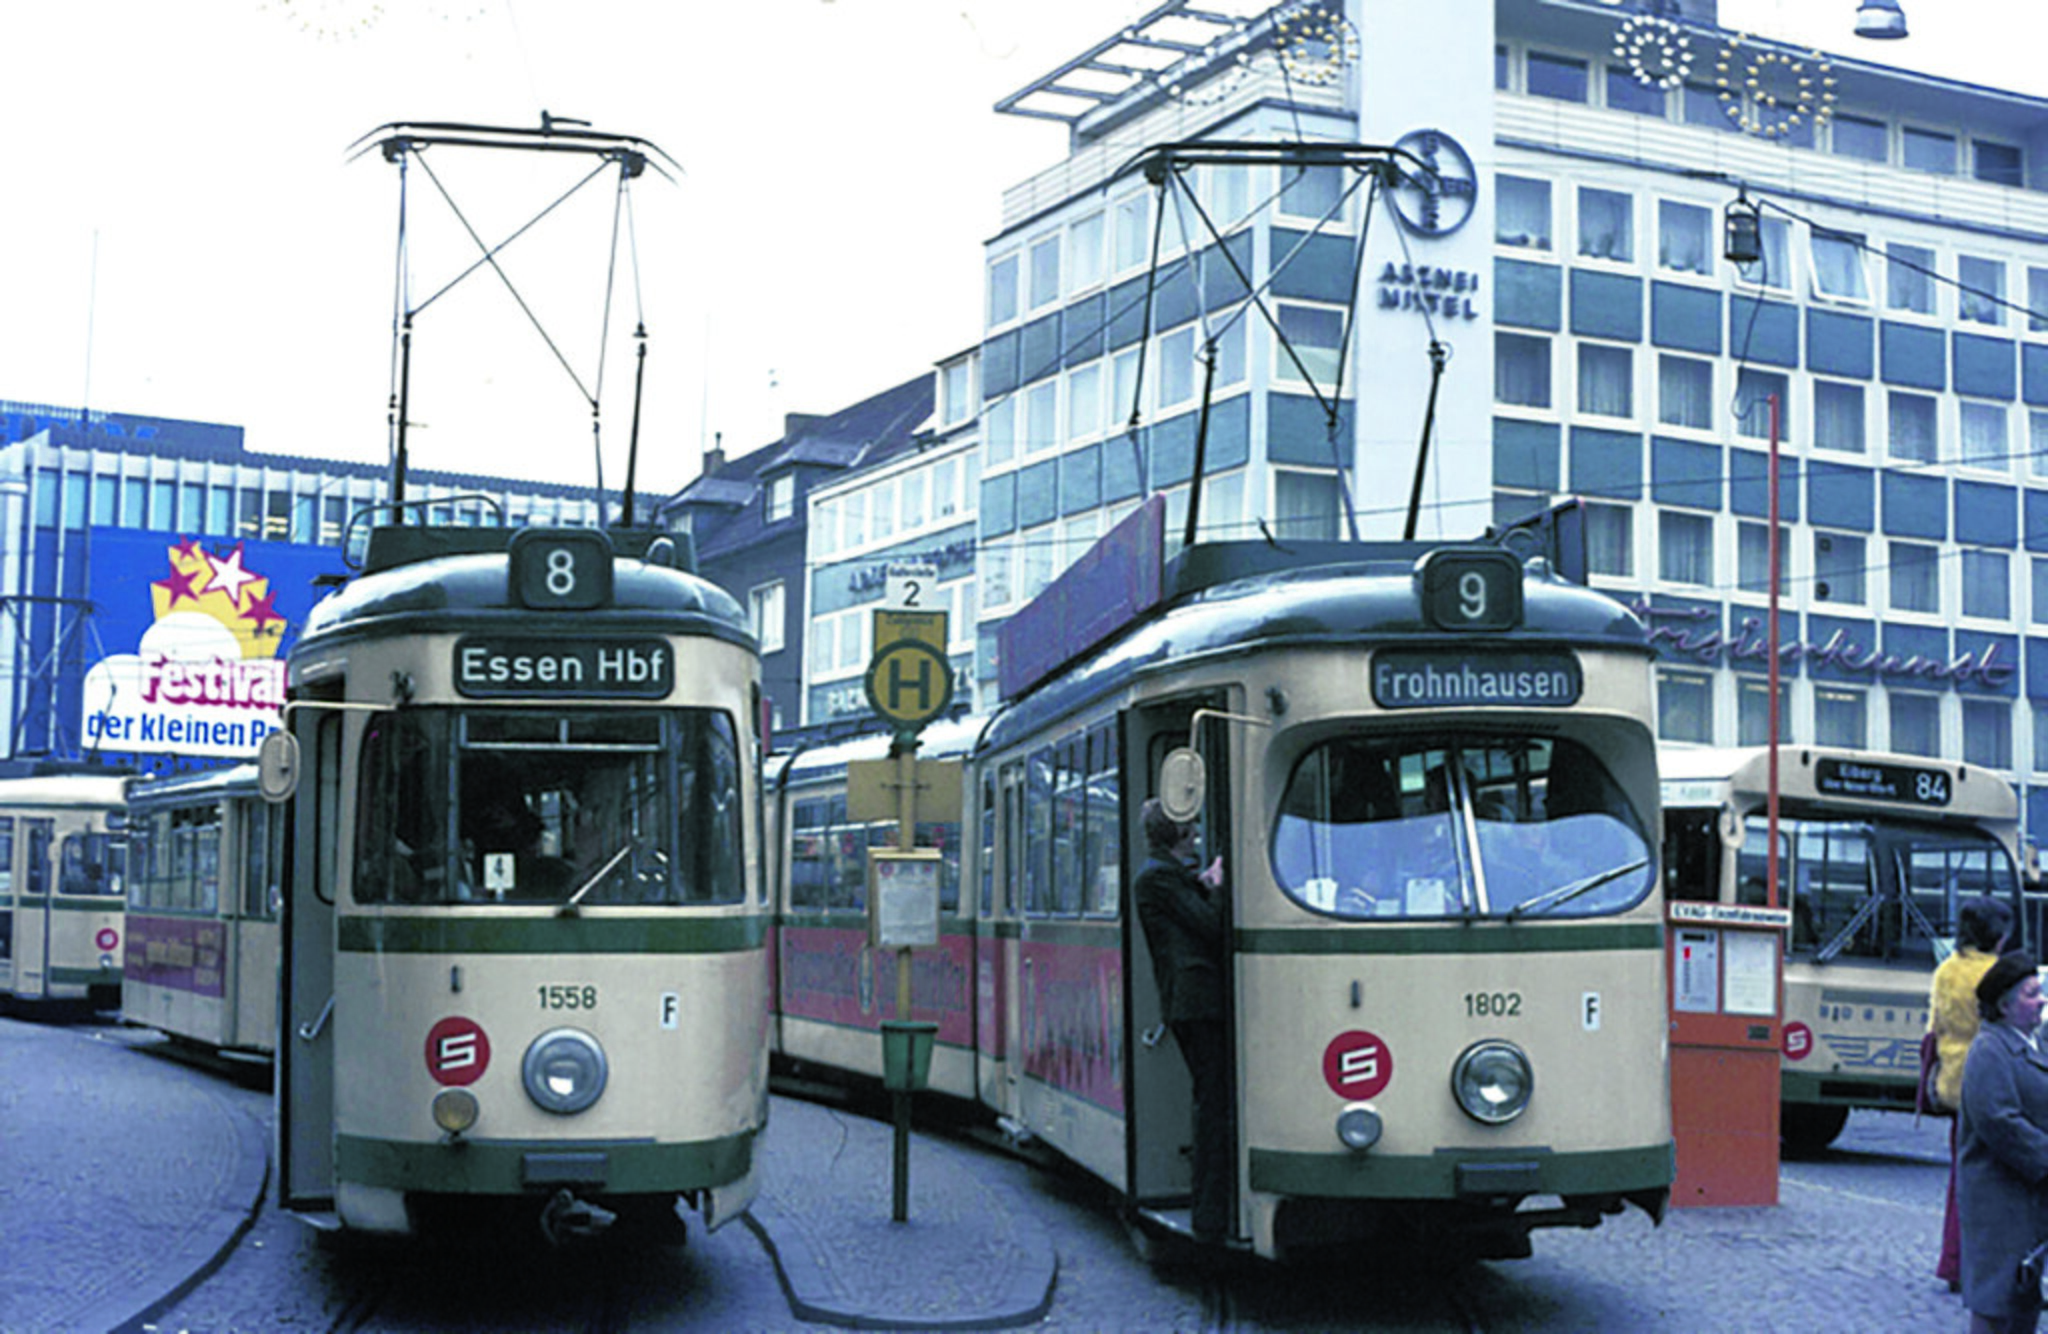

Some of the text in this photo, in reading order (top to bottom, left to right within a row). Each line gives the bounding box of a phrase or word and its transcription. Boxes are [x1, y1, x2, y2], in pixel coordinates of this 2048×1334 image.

[546, 549, 575, 595] 8
[903, 580, 920, 607] 2
[1459, 571, 1486, 618] 9
[139, 653, 289, 711] Festival
[461, 648, 664, 682] Essen Hbf
[1376, 664, 1569, 699] Frohnhausen
[888, 658, 931, 711] H
[87, 709, 135, 741] der
[140, 712, 245, 746] kleinen
[1915, 771, 1947, 800] 84
[537, 985, 597, 1009] 1558
[662, 995, 676, 1024] F
[1464, 993, 1522, 1017] 1802
[1586, 997, 1598, 1024] F
